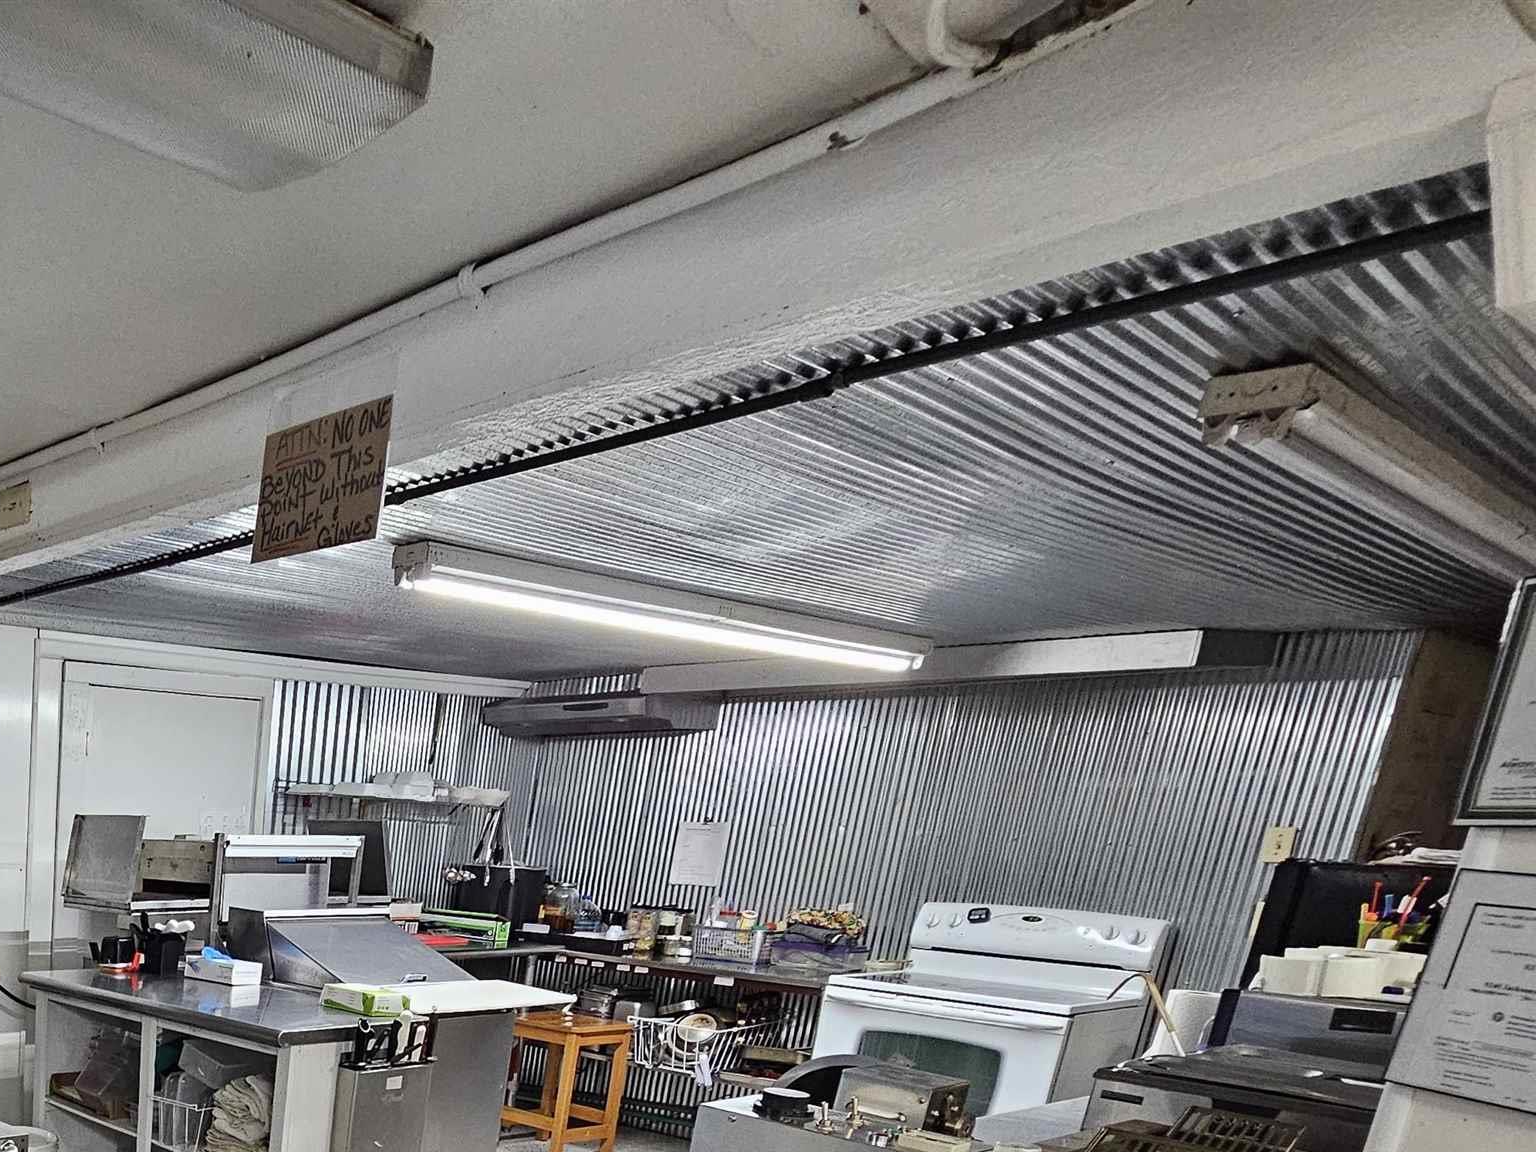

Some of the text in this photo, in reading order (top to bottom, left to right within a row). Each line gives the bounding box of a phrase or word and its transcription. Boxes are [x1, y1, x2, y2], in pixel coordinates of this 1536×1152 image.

[275, 400, 391, 460] ATTN: NO ONE
